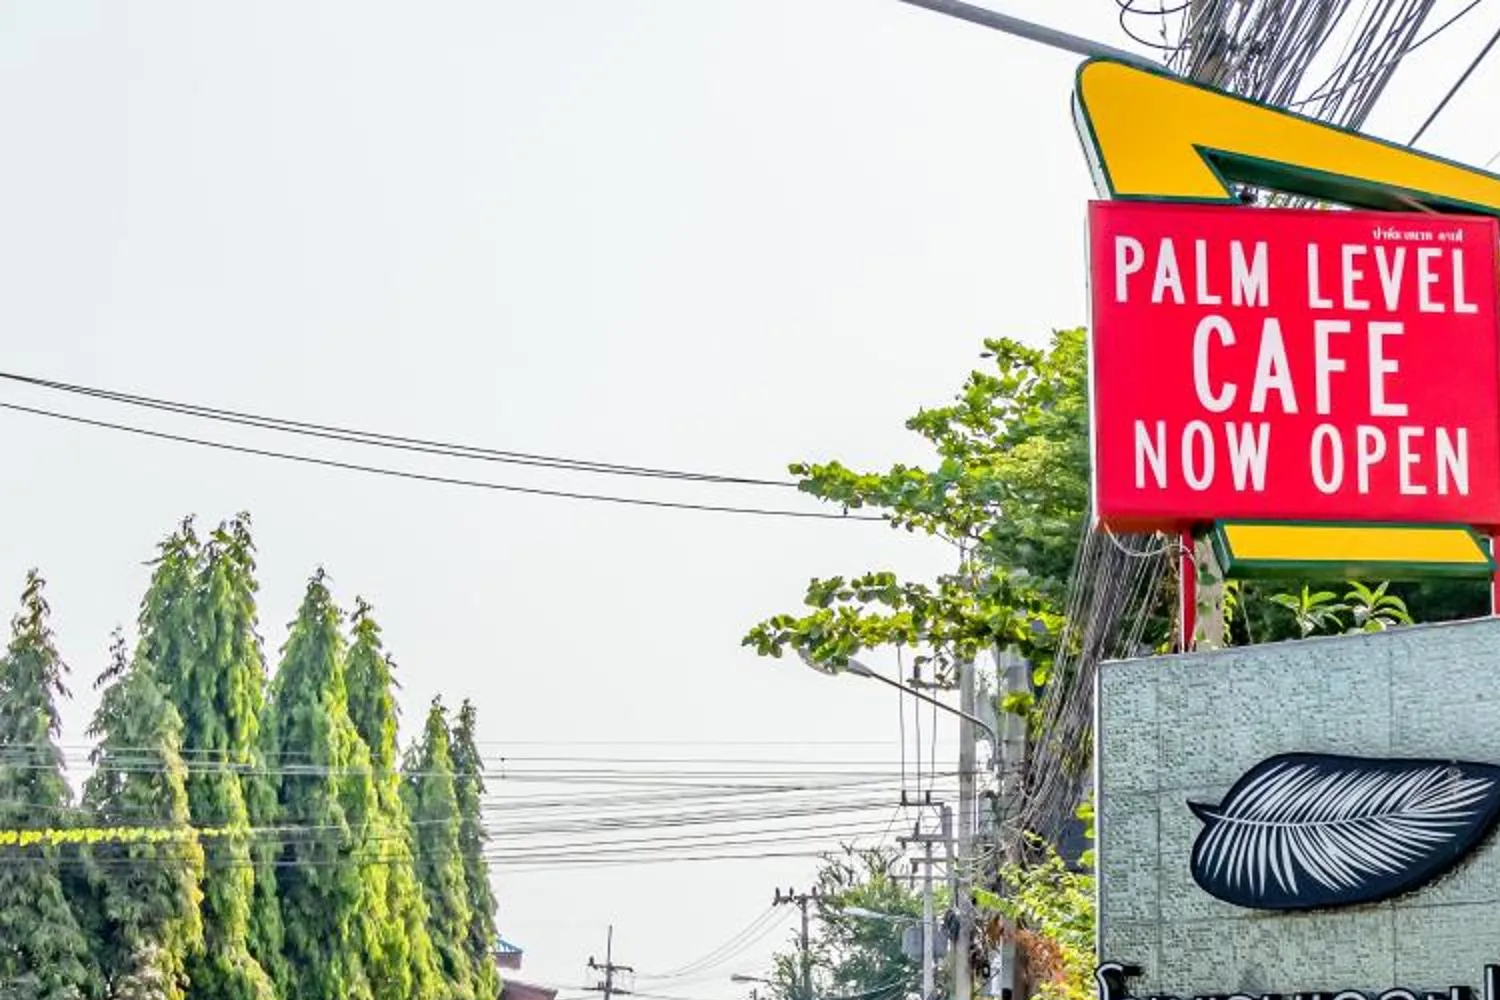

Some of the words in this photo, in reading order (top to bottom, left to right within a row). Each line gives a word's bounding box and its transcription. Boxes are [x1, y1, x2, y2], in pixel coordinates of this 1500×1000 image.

[1114, 236, 1269, 307] PALM
[1307, 243, 1479, 314] LEVEL
[1193, 315, 1409, 417] CAFE
[1134, 420, 1271, 492] NOW
[1310, 423, 1469, 495] OPEN
